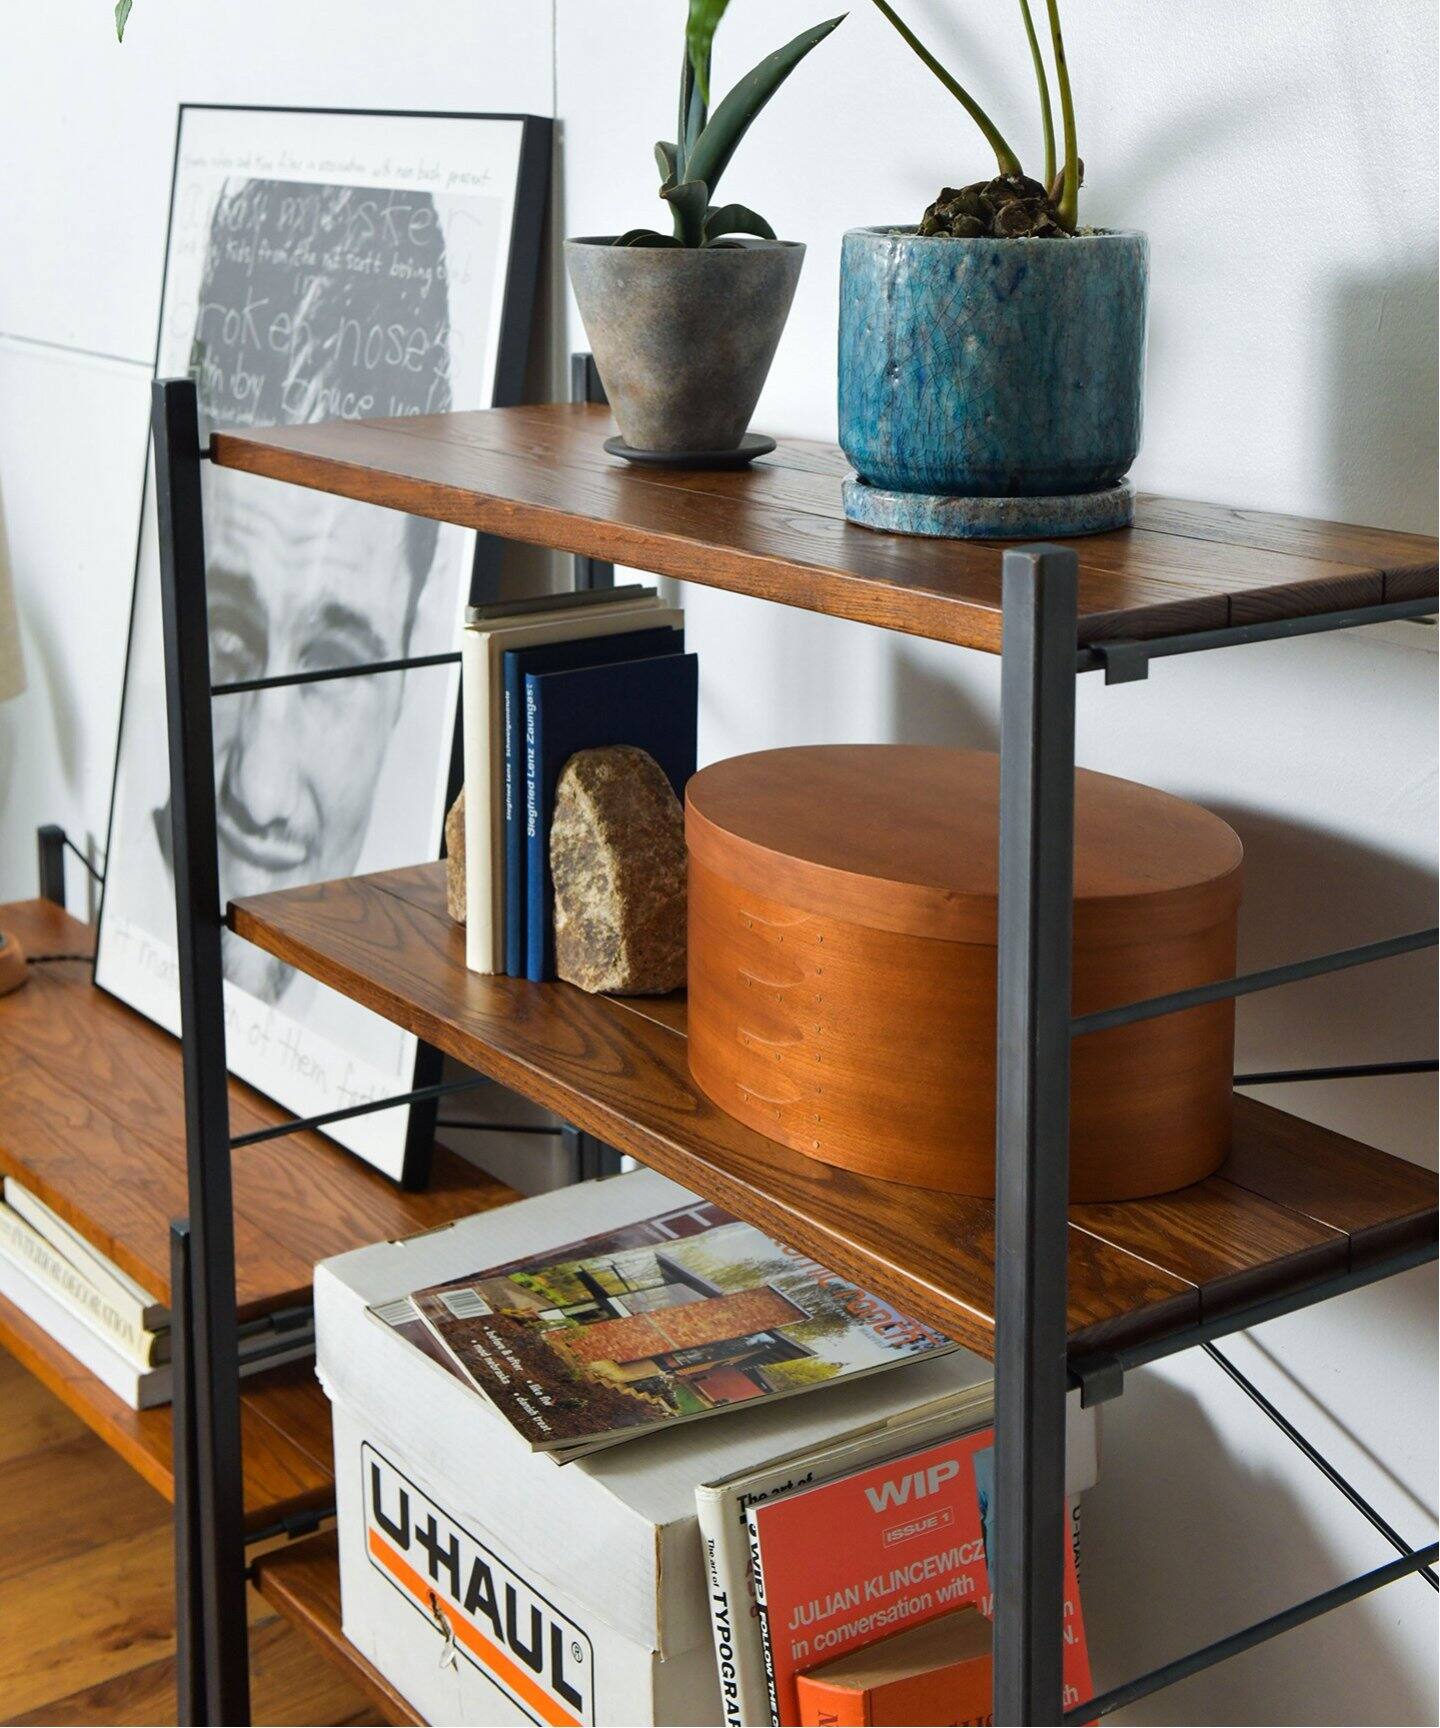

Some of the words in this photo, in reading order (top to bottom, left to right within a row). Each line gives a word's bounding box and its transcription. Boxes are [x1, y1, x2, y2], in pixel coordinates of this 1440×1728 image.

[527, 748, 535, 778] Lenz
[527, 780, 538, 837] Siegfried
[864, 1460, 960, 1513] WIP
[707, 1539, 715, 1558] The
[887, 1516, 938, 1542] ISSUE
[371, 1462, 583, 1714] U-HAUL
[709, 1559, 718, 1575] art
[788, 1584, 861, 1630] JULIAN
[864, 1538, 986, 1602] KLINCEWICZ
[750, 1542, 765, 1599] WIP
[759, 1611, 774, 1678] FOLLOW
[767, 1680, 778, 1713] THE
[791, 1639, 809, 1660] in
[814, 1592, 933, 1651] conversation
[936, 1574, 976, 1604] with
